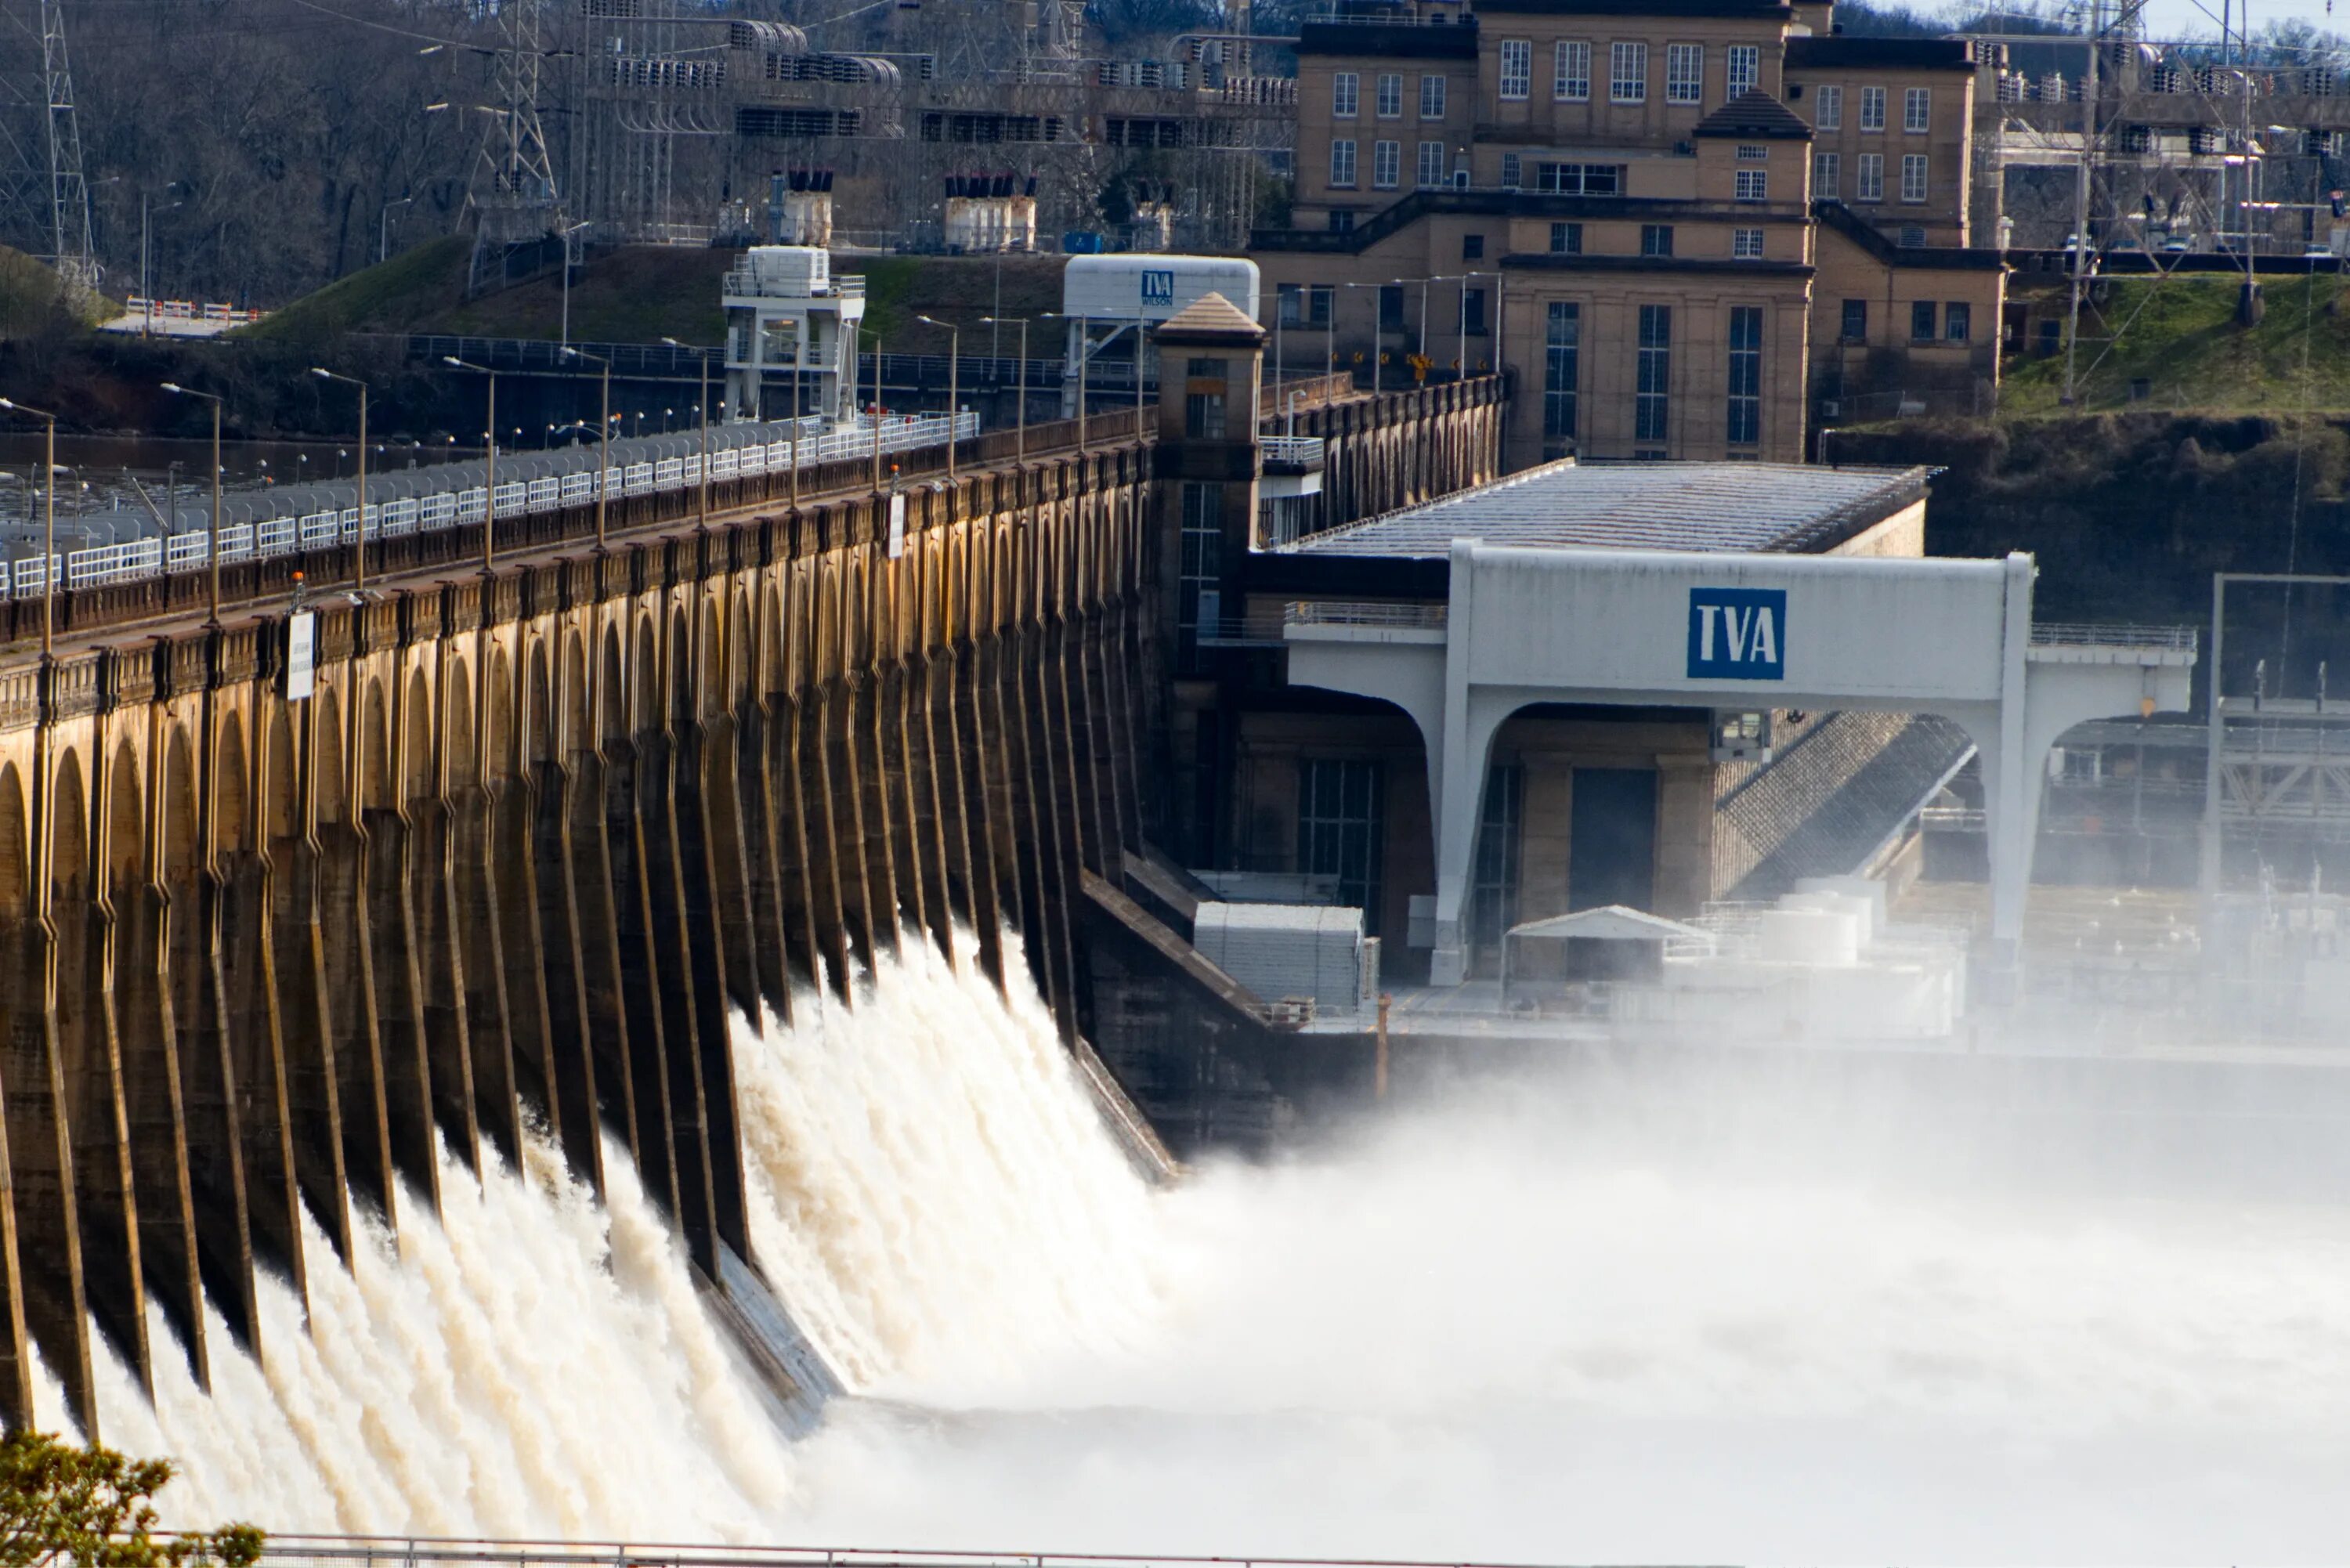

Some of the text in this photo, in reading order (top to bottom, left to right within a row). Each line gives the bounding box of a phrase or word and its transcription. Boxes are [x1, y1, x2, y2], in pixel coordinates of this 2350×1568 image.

[1144, 273, 1170, 295] TVA
[1142, 297, 1173, 306] WILSON
[1697, 605, 1777, 663] TVA
